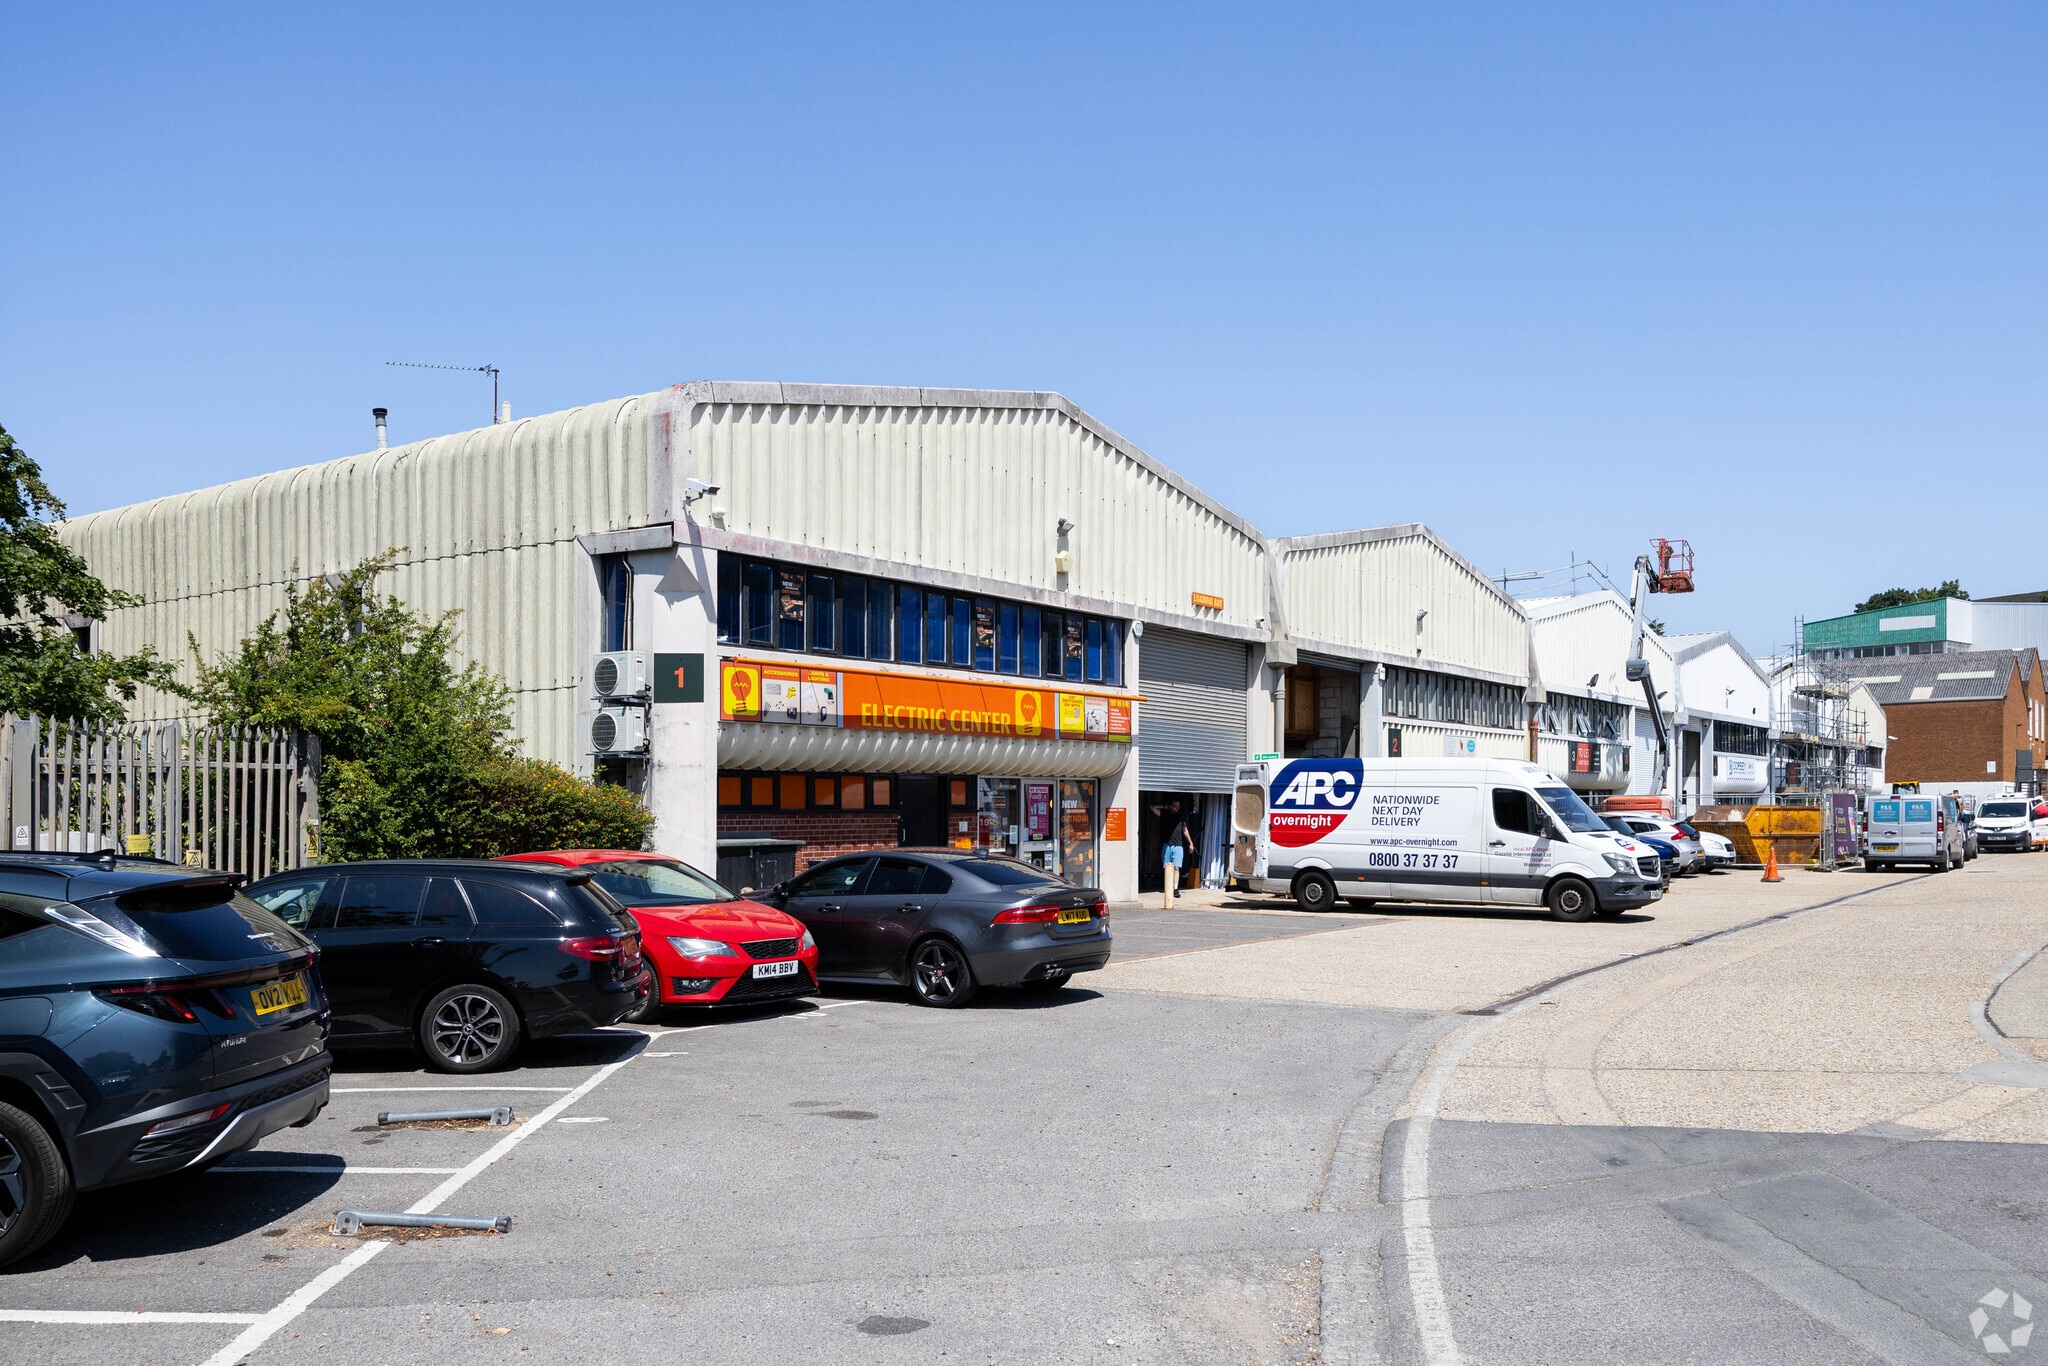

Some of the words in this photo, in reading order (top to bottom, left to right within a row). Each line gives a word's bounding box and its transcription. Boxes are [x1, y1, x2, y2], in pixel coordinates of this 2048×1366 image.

[673, 667, 684, 688] 1
[763, 669, 799, 678] ACCESSORIES
[861, 703, 946, 731] ELECTRIC
[951, 709, 1011, 734] CENTER
[1392, 737, 1398, 752] 2
[1571, 750, 1576, 761] 3
[1274, 771, 1356, 807] APC
[1061, 800, 1077, 809] NEW
[1373, 795, 1440, 805] NATIONWIDE
[1372, 806, 1399, 815] NEXT
[1402, 806, 1424, 816] DAY
[1273, 814, 1331, 829] overnight
[1371, 816, 1421, 826] DELIVERY
[1370, 838, 1458, 847] www.apc-overnight.com
[1369, 852, 1399, 867] 0800
[1403, 853, 1419, 868] 37
[1422, 854, 1439, 868] 37
[1442, 854, 1459, 869] 37
[758, 964, 777, 976] KM14
[779, 962, 794, 974] BBV
